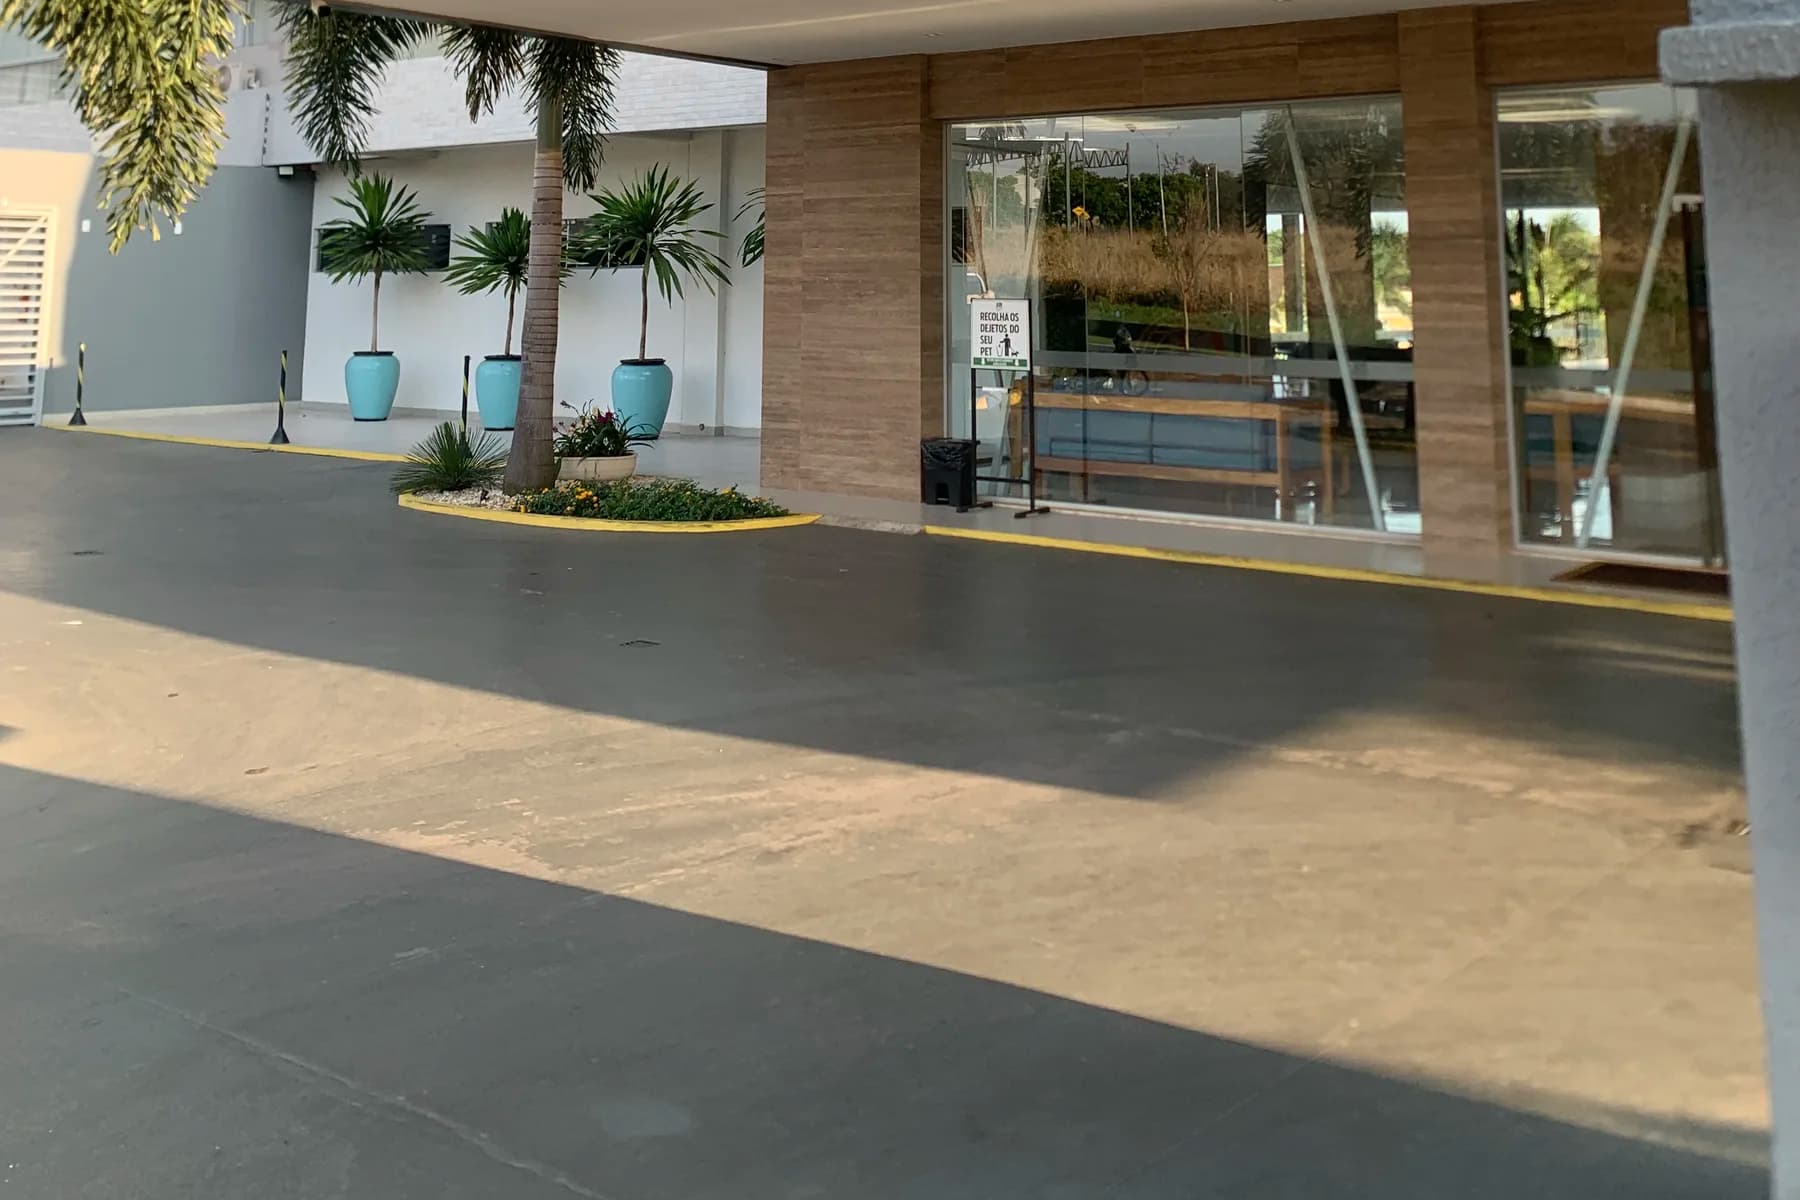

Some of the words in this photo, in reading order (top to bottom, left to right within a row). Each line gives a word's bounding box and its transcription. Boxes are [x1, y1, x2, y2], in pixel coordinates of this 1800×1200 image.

[980, 312, 1009, 322] RECOLHA
[1010, 313, 1019, 322] OS
[980, 324, 1008, 333] DEJETOS
[1010, 324, 1020, 334] DO
[980, 335, 993, 345] SEU
[980, 347, 992, 356] PET
